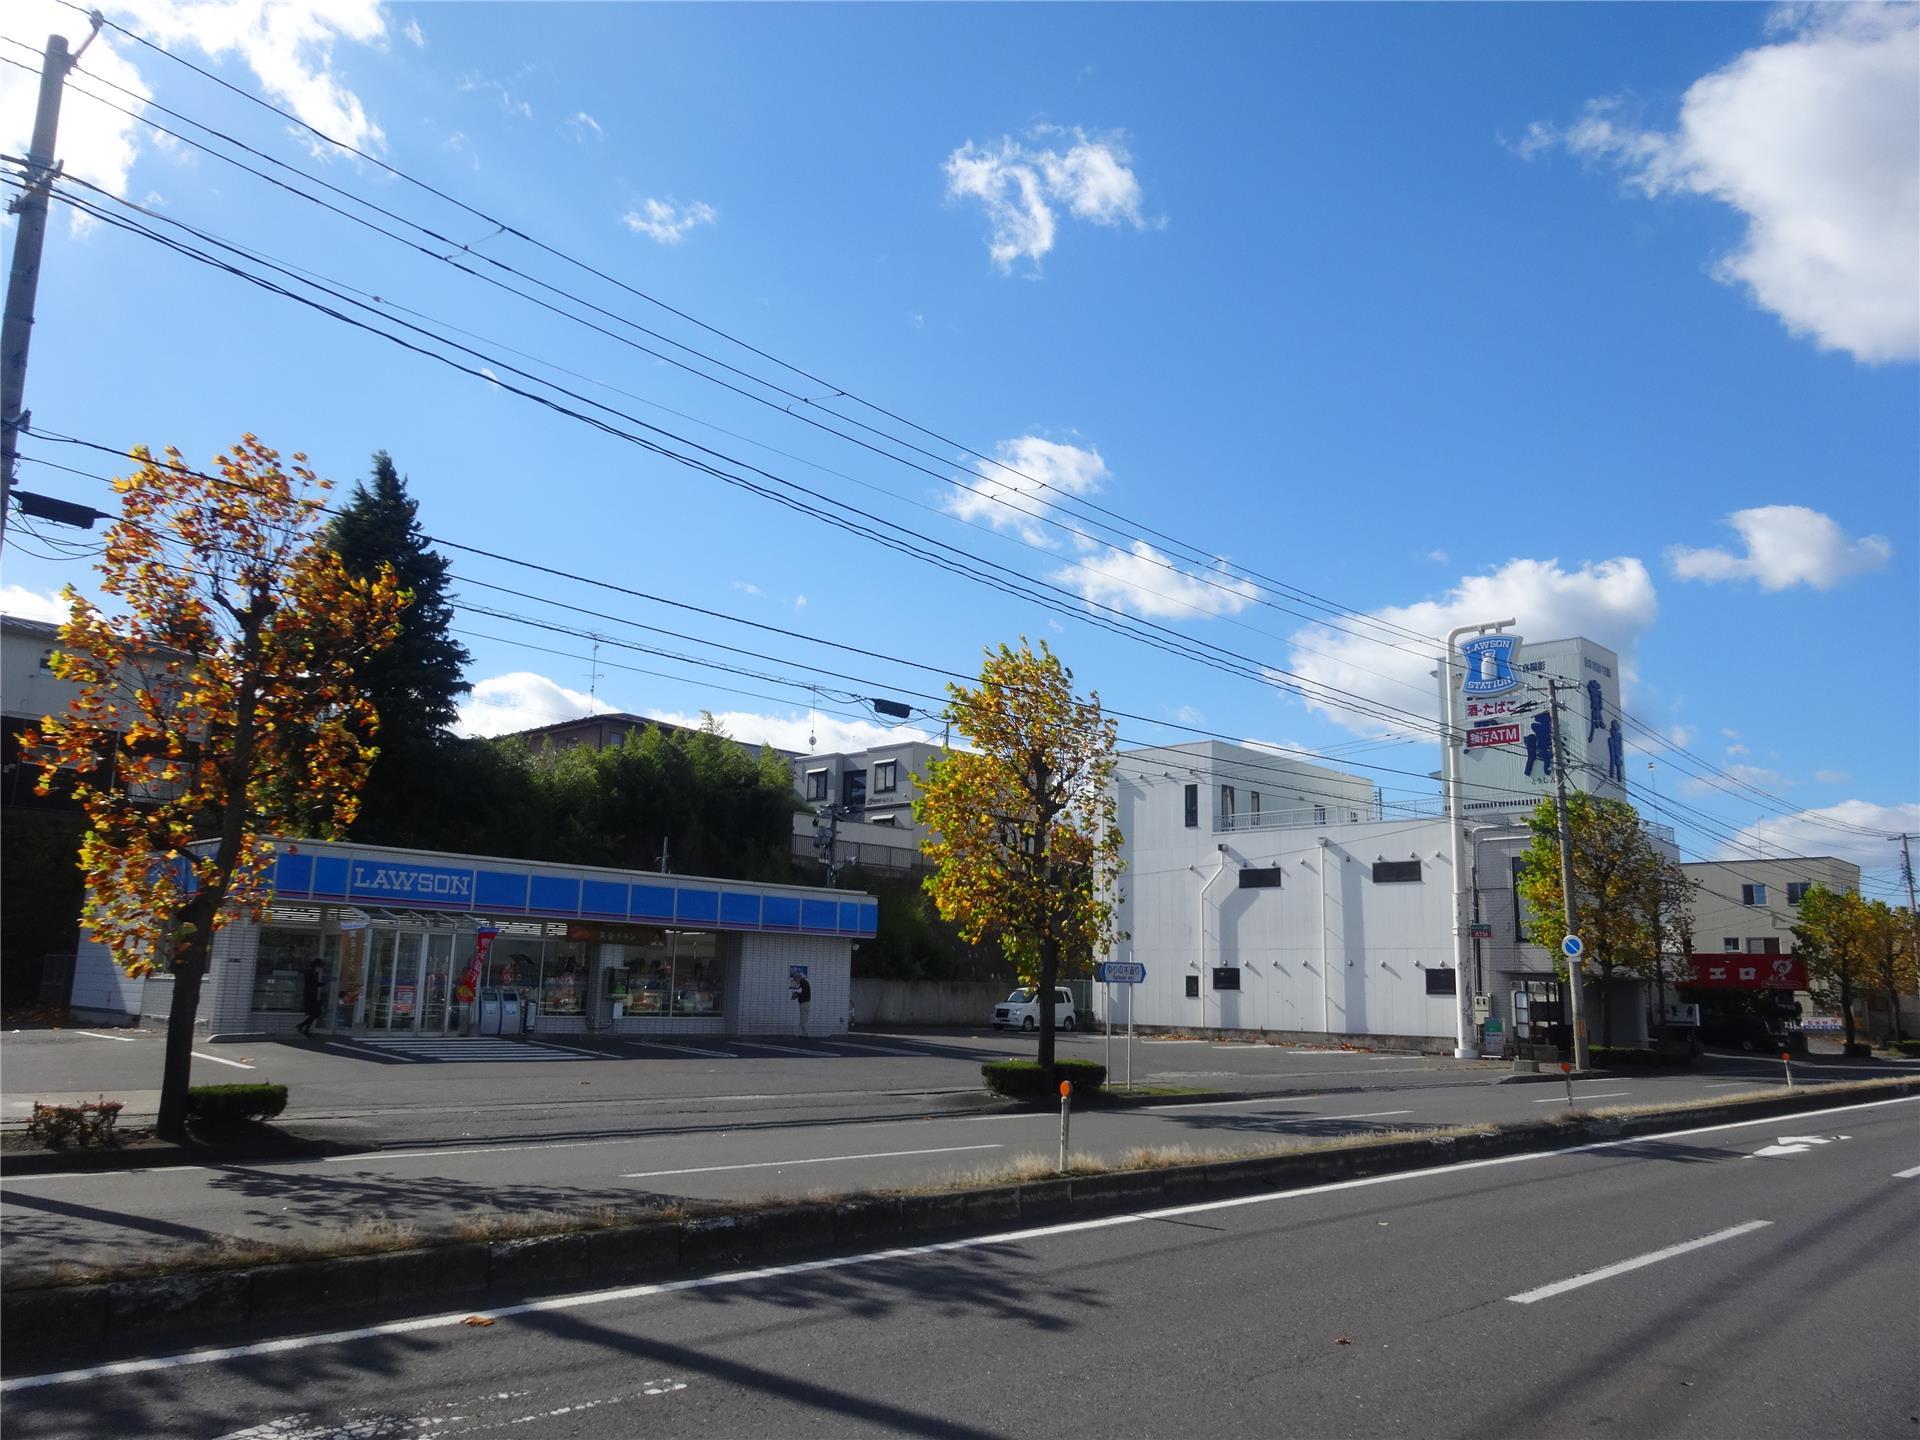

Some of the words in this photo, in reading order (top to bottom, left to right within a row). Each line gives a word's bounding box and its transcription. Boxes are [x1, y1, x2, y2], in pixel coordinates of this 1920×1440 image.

[1465, 640, 1510, 654] LAWSON
[1467, 676, 1512, 690] STATION
[354, 867, 471, 895] LAWSON
